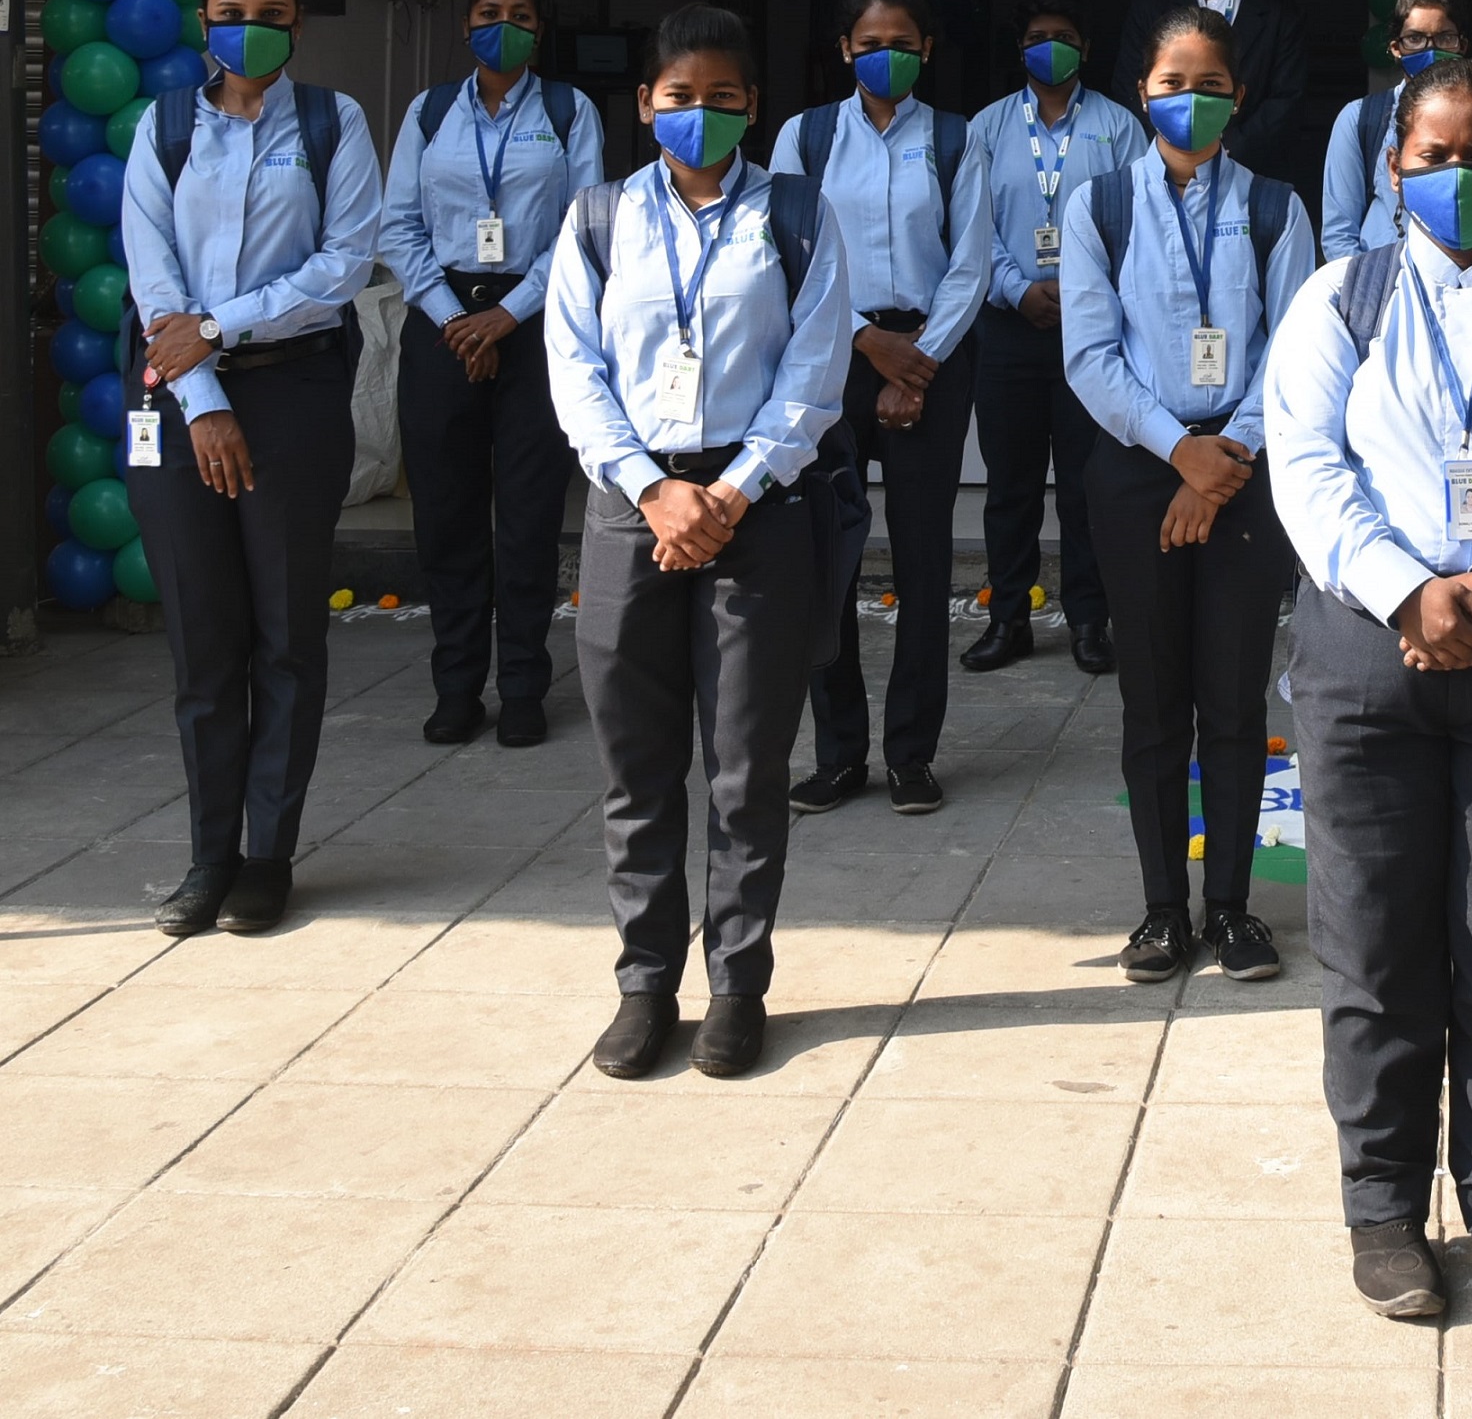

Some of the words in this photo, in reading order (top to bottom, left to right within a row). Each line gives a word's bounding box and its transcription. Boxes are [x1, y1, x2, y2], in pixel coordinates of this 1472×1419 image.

[513, 134, 534, 142] BLUE
[903, 151, 923, 160] BLUE
[265, 157, 291, 166] BLUE
[1213, 226, 1238, 237] BLUE
[726, 233, 754, 245] BLUE
